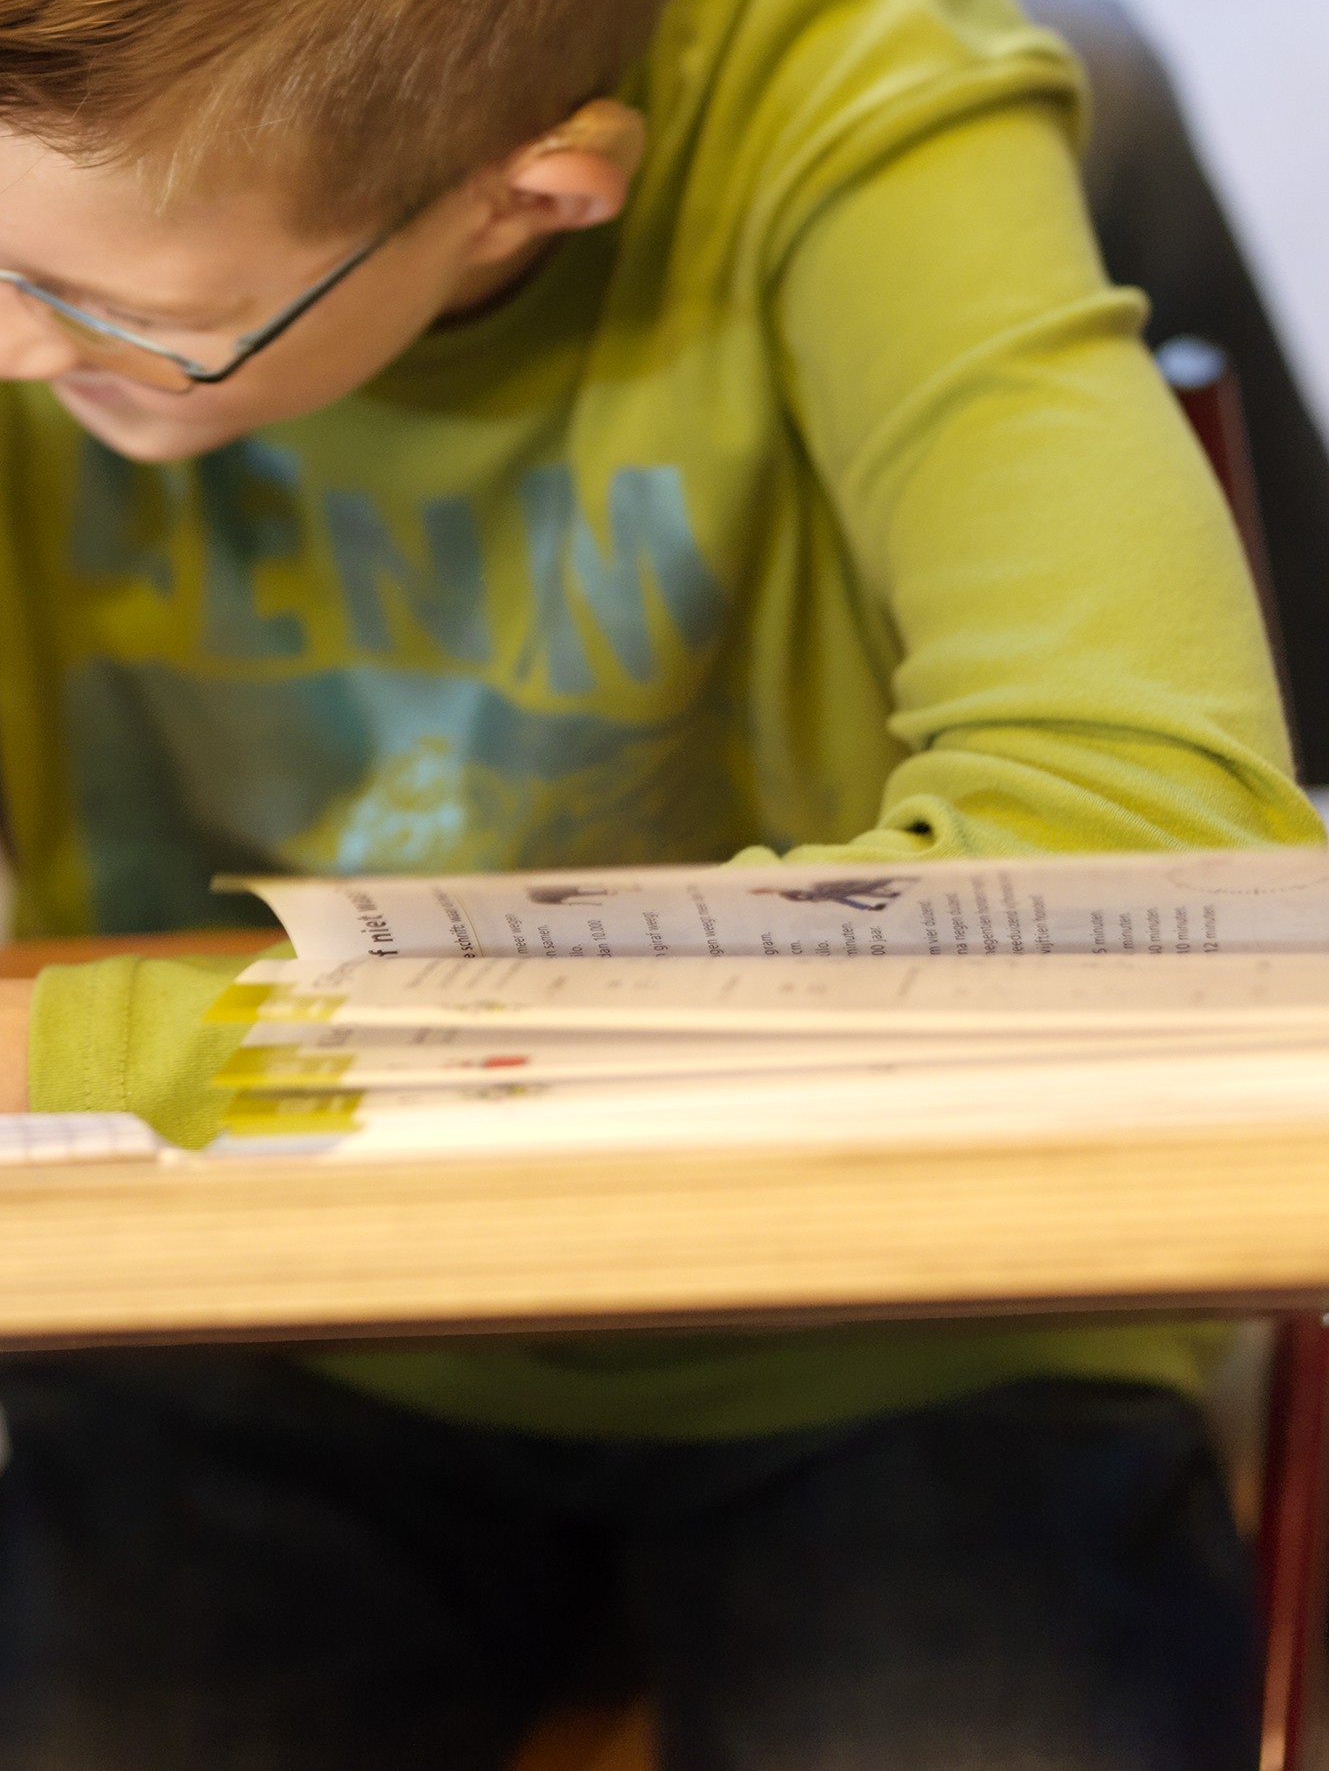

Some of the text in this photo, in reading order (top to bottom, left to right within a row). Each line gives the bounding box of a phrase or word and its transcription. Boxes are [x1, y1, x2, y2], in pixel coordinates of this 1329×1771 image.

[358, 913, 394, 942] niet
[537, 923, 555, 949] samen.
[587, 919, 607, 941] 10.000
[868, 925, 888, 943] jaar.
[923, 928, 939, 944] vier
[951, 916, 969, 940] negen
[1034, 922, 1055, 954] vijftien
[1118, 911, 1134, 949] minuten.
[512, 934, 529, 954] meer
[645, 931, 669, 951] giraf
[706, 938, 725, 957] gen
[760, 931, 780, 955] gram.
[790, 939, 803, 955] cm.
[1203, 942, 1219, 953] 12
